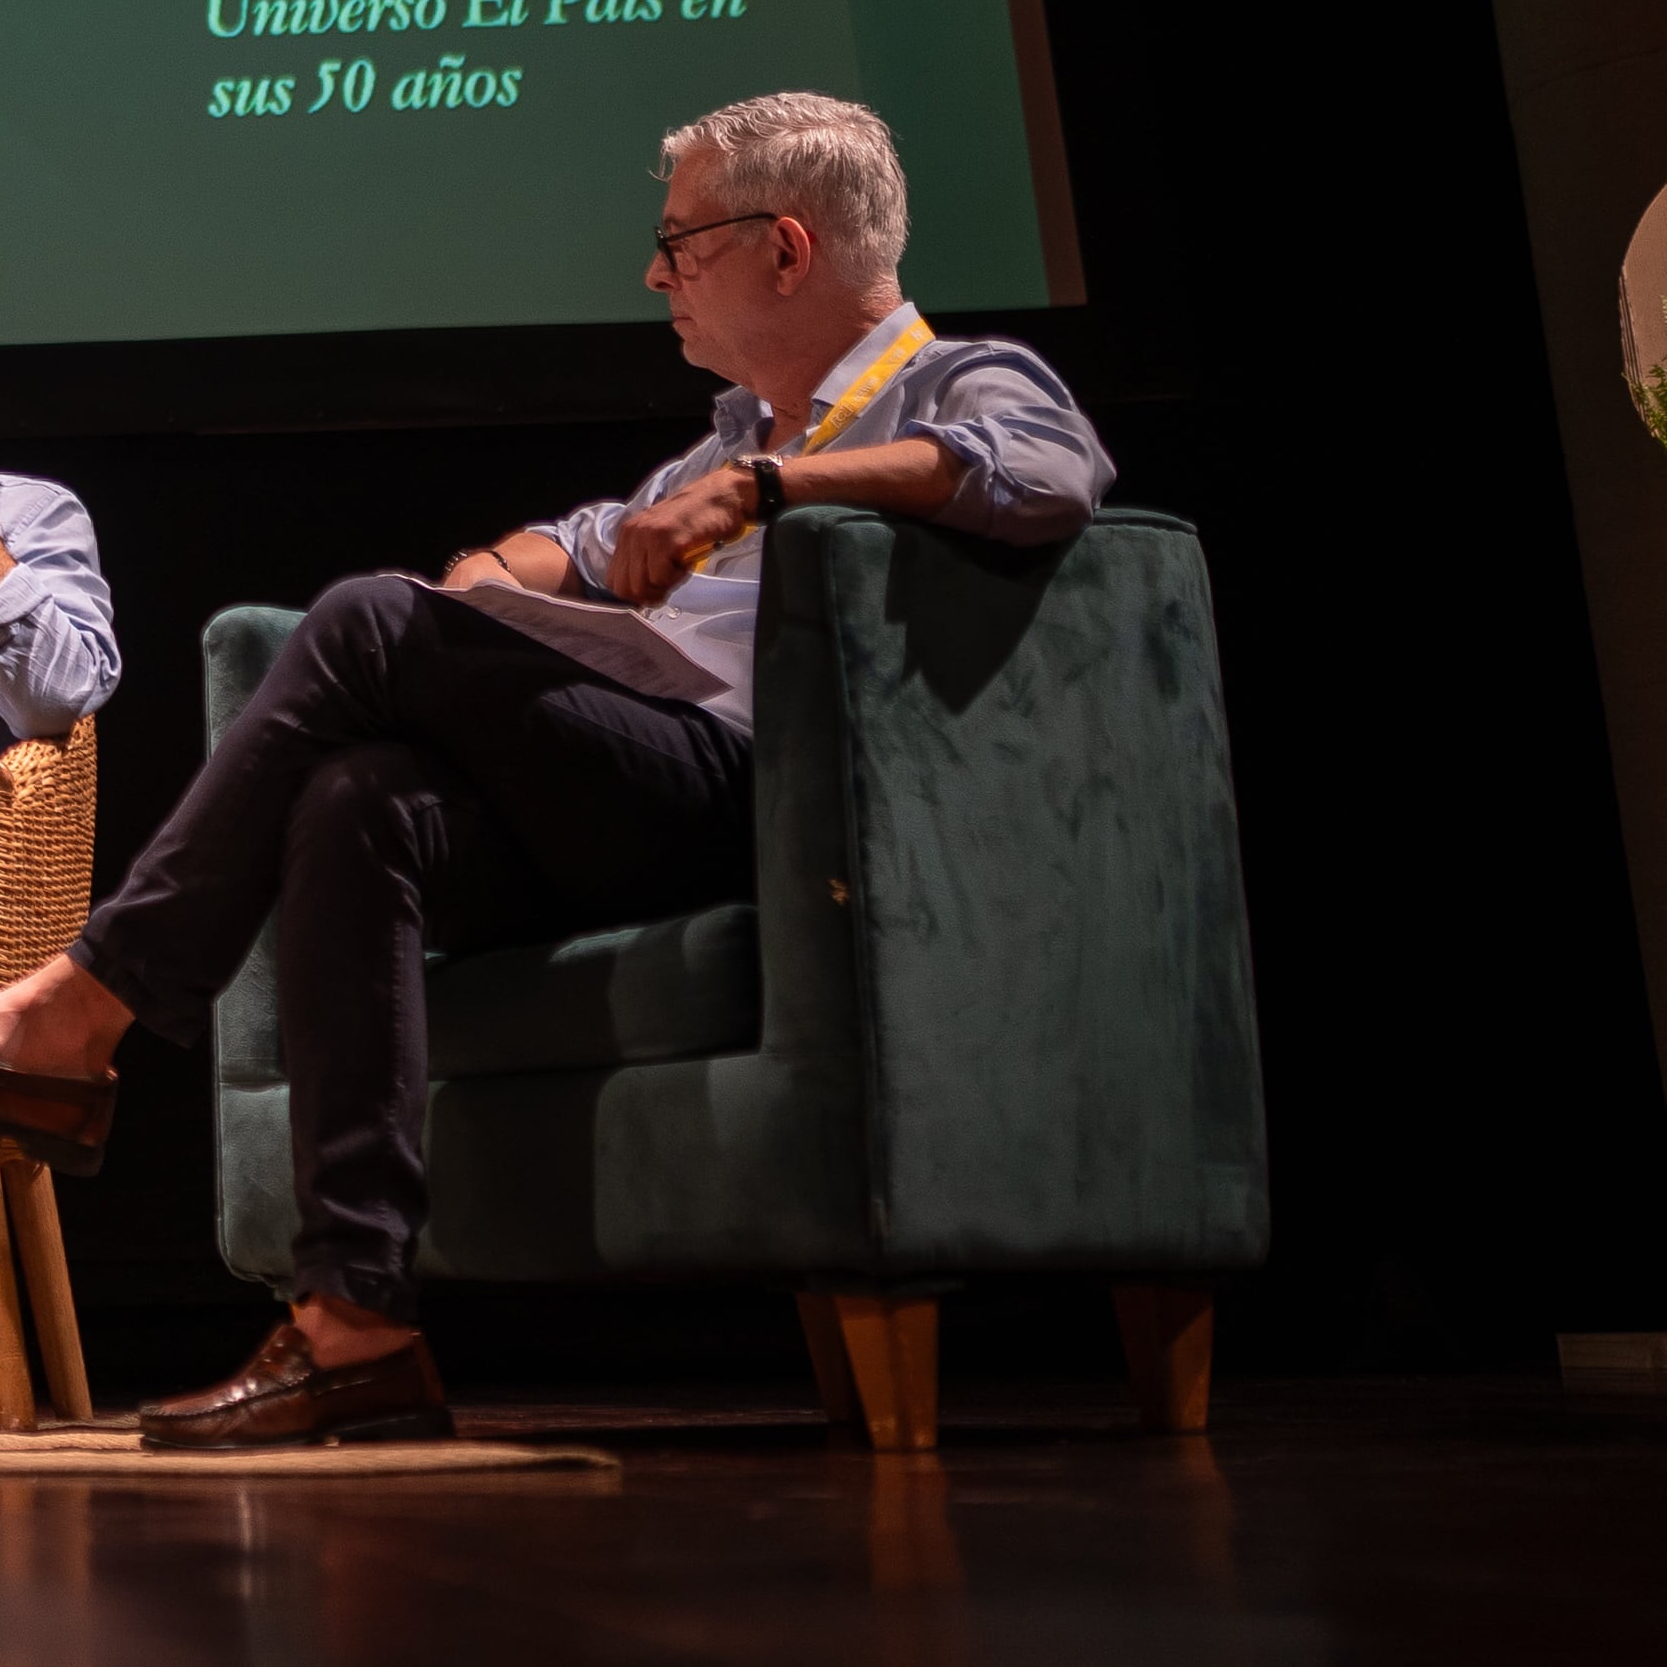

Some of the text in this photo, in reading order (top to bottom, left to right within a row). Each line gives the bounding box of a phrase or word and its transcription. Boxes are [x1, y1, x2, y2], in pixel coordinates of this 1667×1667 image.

[207, 54, 522, 118] sus 50 años
